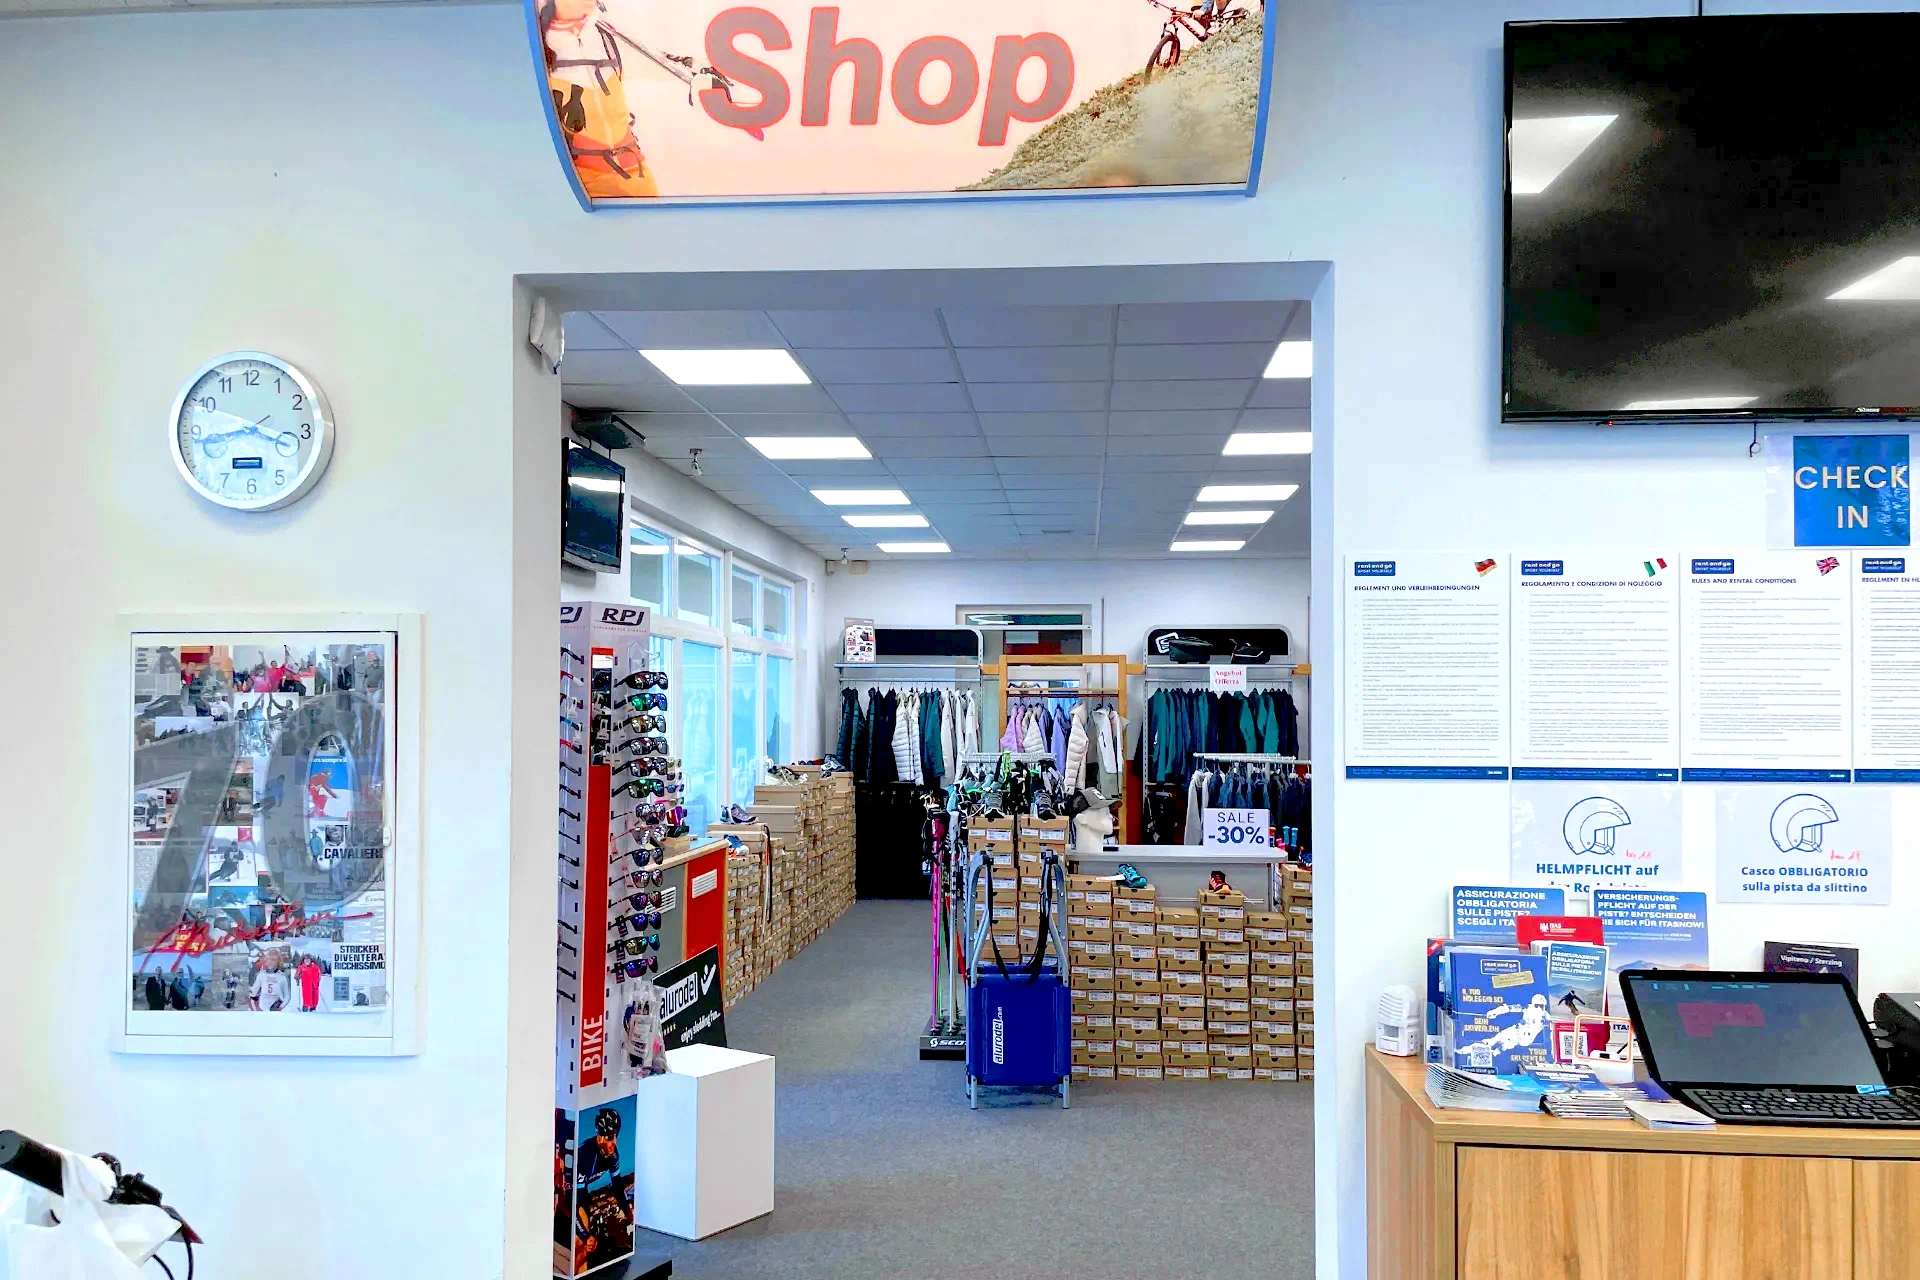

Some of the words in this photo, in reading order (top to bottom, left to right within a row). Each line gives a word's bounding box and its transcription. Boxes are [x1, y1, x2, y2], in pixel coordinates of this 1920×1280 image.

[700, 6, 1075, 147] Shop
[218, 378, 232, 393] 11
[243, 370, 260, 386] 12
[274, 378, 281, 393] 1
[198, 396, 216, 412] 10
[292, 394, 303, 411] 2
[191, 425, 202, 441] 9
[300, 424, 311, 440] 3
[220, 473, 230, 489] 7
[275, 470, 285, 486] 5
[1795, 465, 1909, 489] CHECK
[246, 478, 257, 494] 6
[1837, 505, 1868, 529] IN
[560, 606, 583, 624] PJ
[598, 607, 645, 627] RPJ
[1217, 812, 1255, 824] SALE
[1208, 826, 1265, 844] -30%
[1536, 863, 1632, 875] HELMPFLICHT
[1635, 865, 1659, 876] auf
[1741, 866, 1775, 876] Casco
[1778, 867, 1869, 877] OBBLIGATORIO
[1457, 889, 1546, 900] ASSICURAZIONE
[1742, 881, 1770, 891] sulla
[1773, 882, 1803, 893] pista
[1806, 883, 1821, 892] da
[1824, 883, 1868, 893] slittino
[1457, 900, 1538, 909] OBBLIGATORIA
[1597, 893, 1680, 902] VERSICHERUNGS-
[1457, 908, 1491, 917] SULLE
[1493, 909, 1531, 917] PISTE?
[1597, 901, 1637, 909] PFLICHT
[1638, 902, 1656, 910] AUF
[1658, 902, 1677, 911] DER
[1457, 917, 1496, 926] SCEGLI
[1498, 918, 1516, 926] ITA
[1598, 910, 1629, 918] PISTE?
[1631, 911, 1697, 919] ENTSCHEIDEN
[1615, 919, 1637, 927] SICH
[1639, 918, 1657, 927] FÜR
[1658, 920, 1705, 929] ITASNOW!
[340, 945, 379, 953] STRICKER
[1551, 951, 1600, 960] ASSICURAZIONE
[1551, 956, 1595, 965] OBBLIGATORIA
[660, 972, 699, 1020] alurodel
[583, 1014, 603, 1072] BIKE
[1528, 1048, 1547, 1056] YOUR
